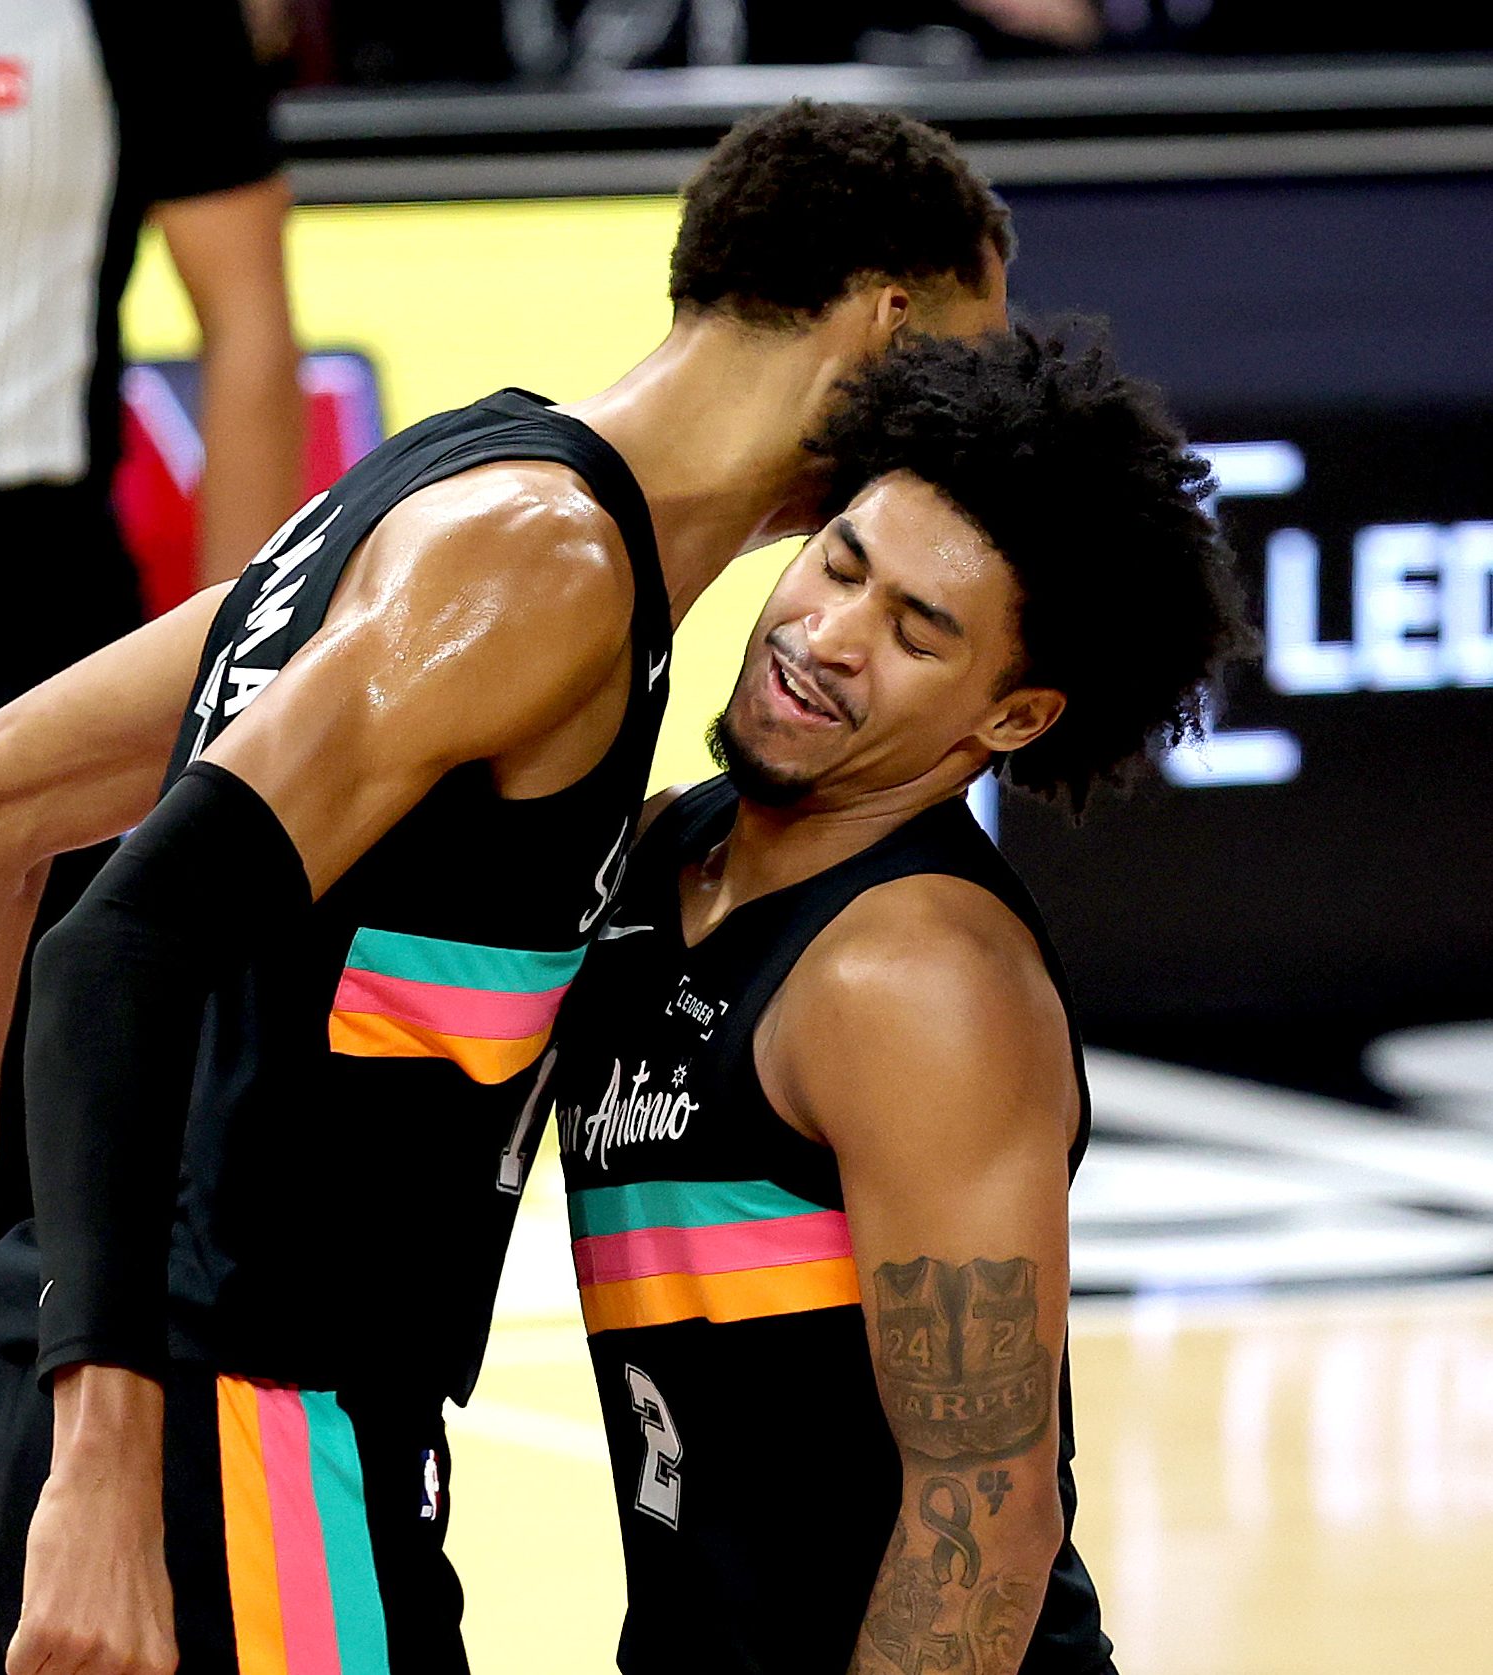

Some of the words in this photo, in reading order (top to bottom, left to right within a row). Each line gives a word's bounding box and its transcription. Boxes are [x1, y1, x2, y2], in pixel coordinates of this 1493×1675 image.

[676, 989, 714, 1026] LEDGER
[584, 1058, 699, 1170] Antonio
[886, 1327, 932, 1368] 24
[624, 1362, 683, 1531] 2
